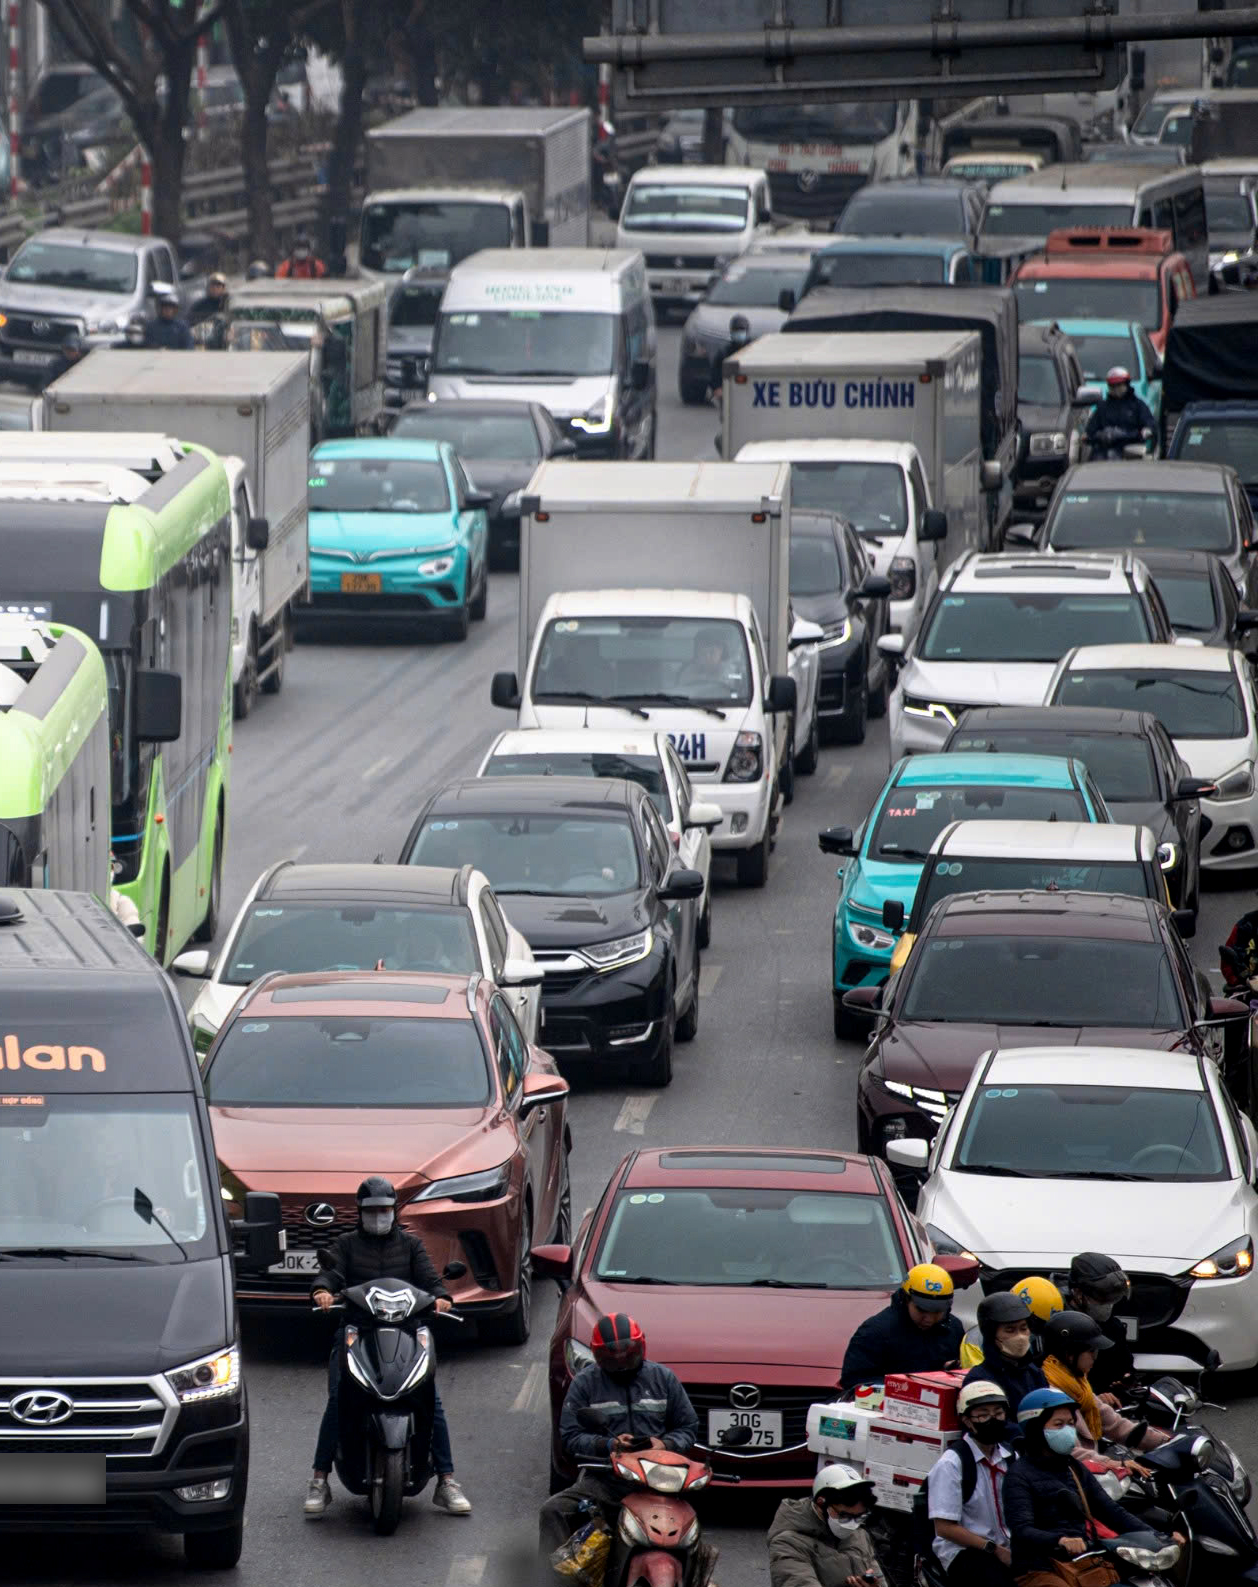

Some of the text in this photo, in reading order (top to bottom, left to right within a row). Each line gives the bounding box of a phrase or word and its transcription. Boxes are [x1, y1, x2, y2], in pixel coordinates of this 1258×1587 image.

[752, 382, 780, 408] XE
[789, 378, 835, 408] BƯU
[844, 376, 914, 408] CHÍNH
[888, 808, 916, 816] TAXI
[925, 1279, 942, 1292] be
[730, 1413, 761, 1428] 30G
